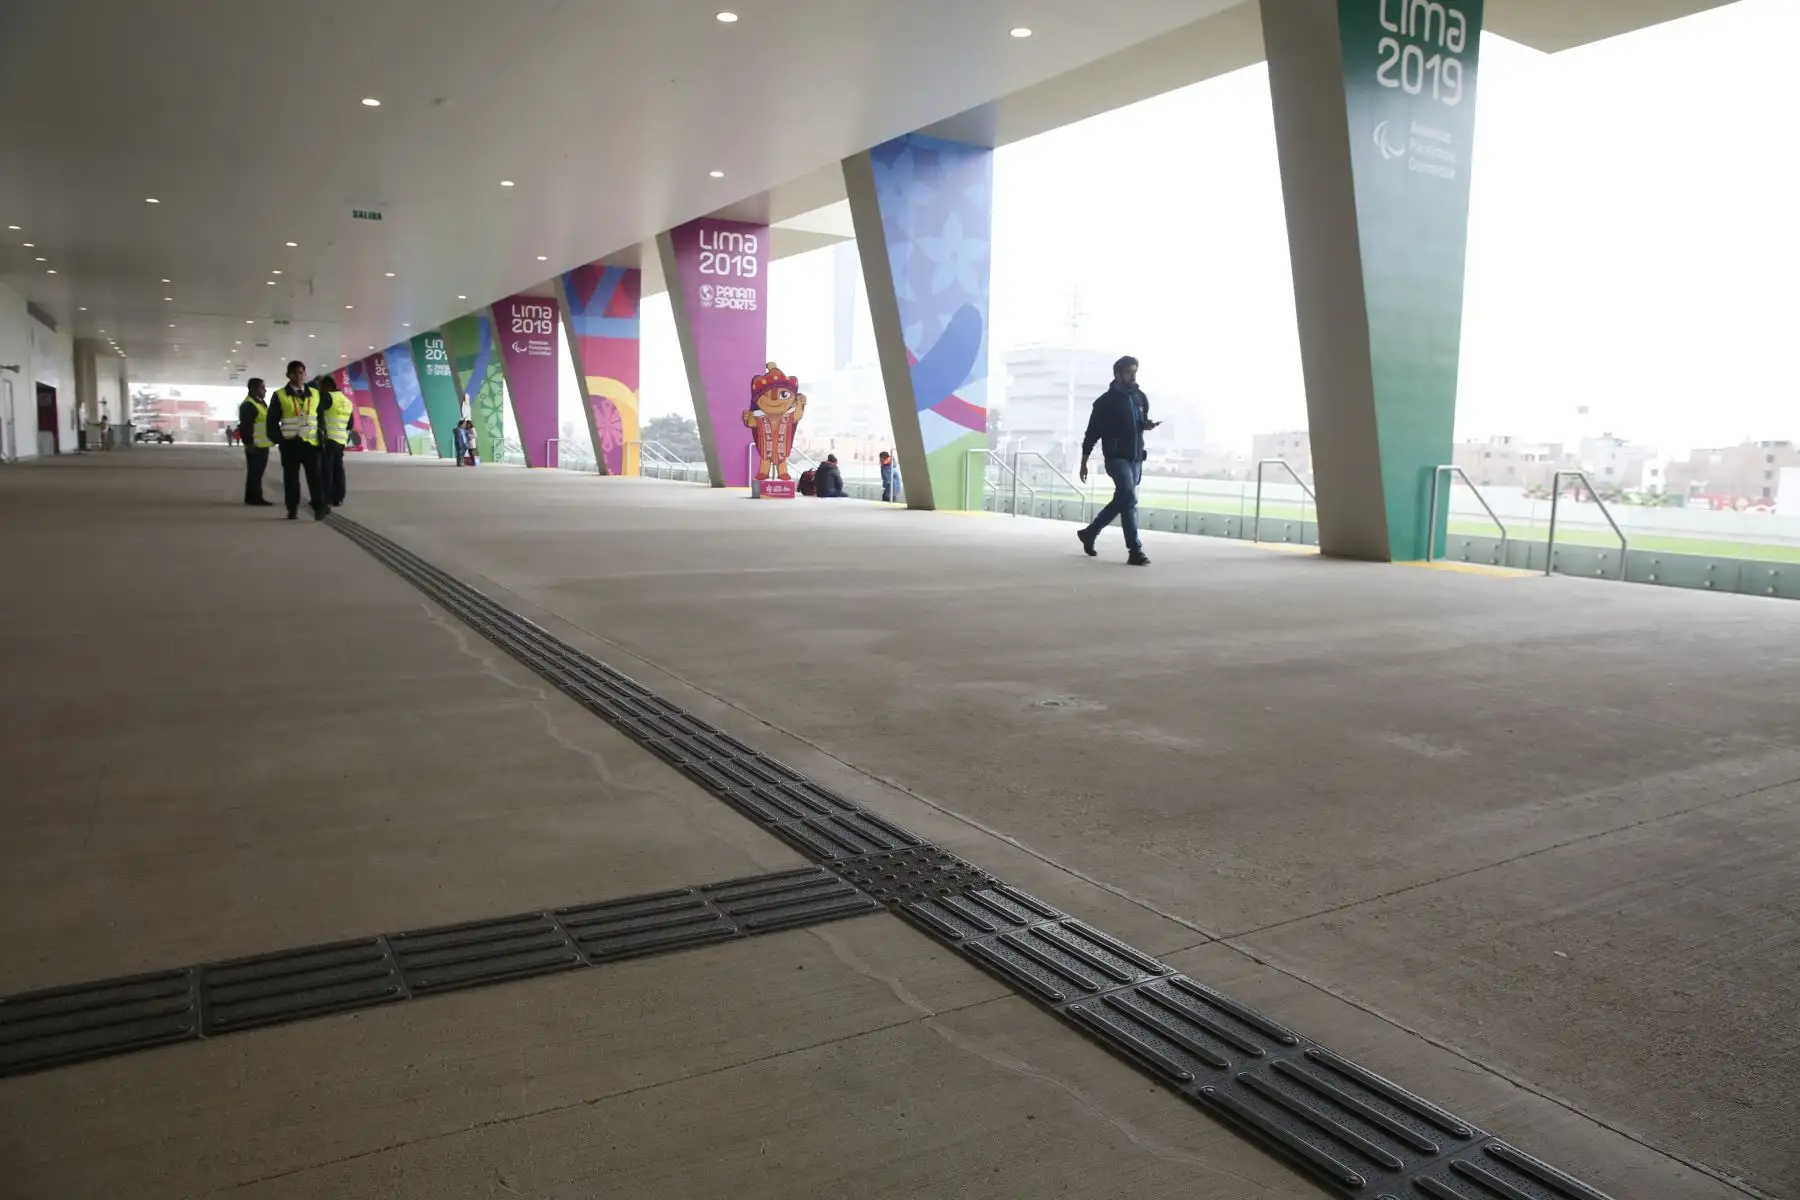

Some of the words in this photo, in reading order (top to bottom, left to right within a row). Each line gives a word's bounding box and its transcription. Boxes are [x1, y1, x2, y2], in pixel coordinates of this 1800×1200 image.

[1377, 37, 1462, 106] 2019
[699, 252, 757, 277] 2019
[716, 285, 755, 299] PANAM
[715, 297, 756, 310] SPORTS
[512, 319, 552, 334] 2019
[425, 349, 448, 360] 201
